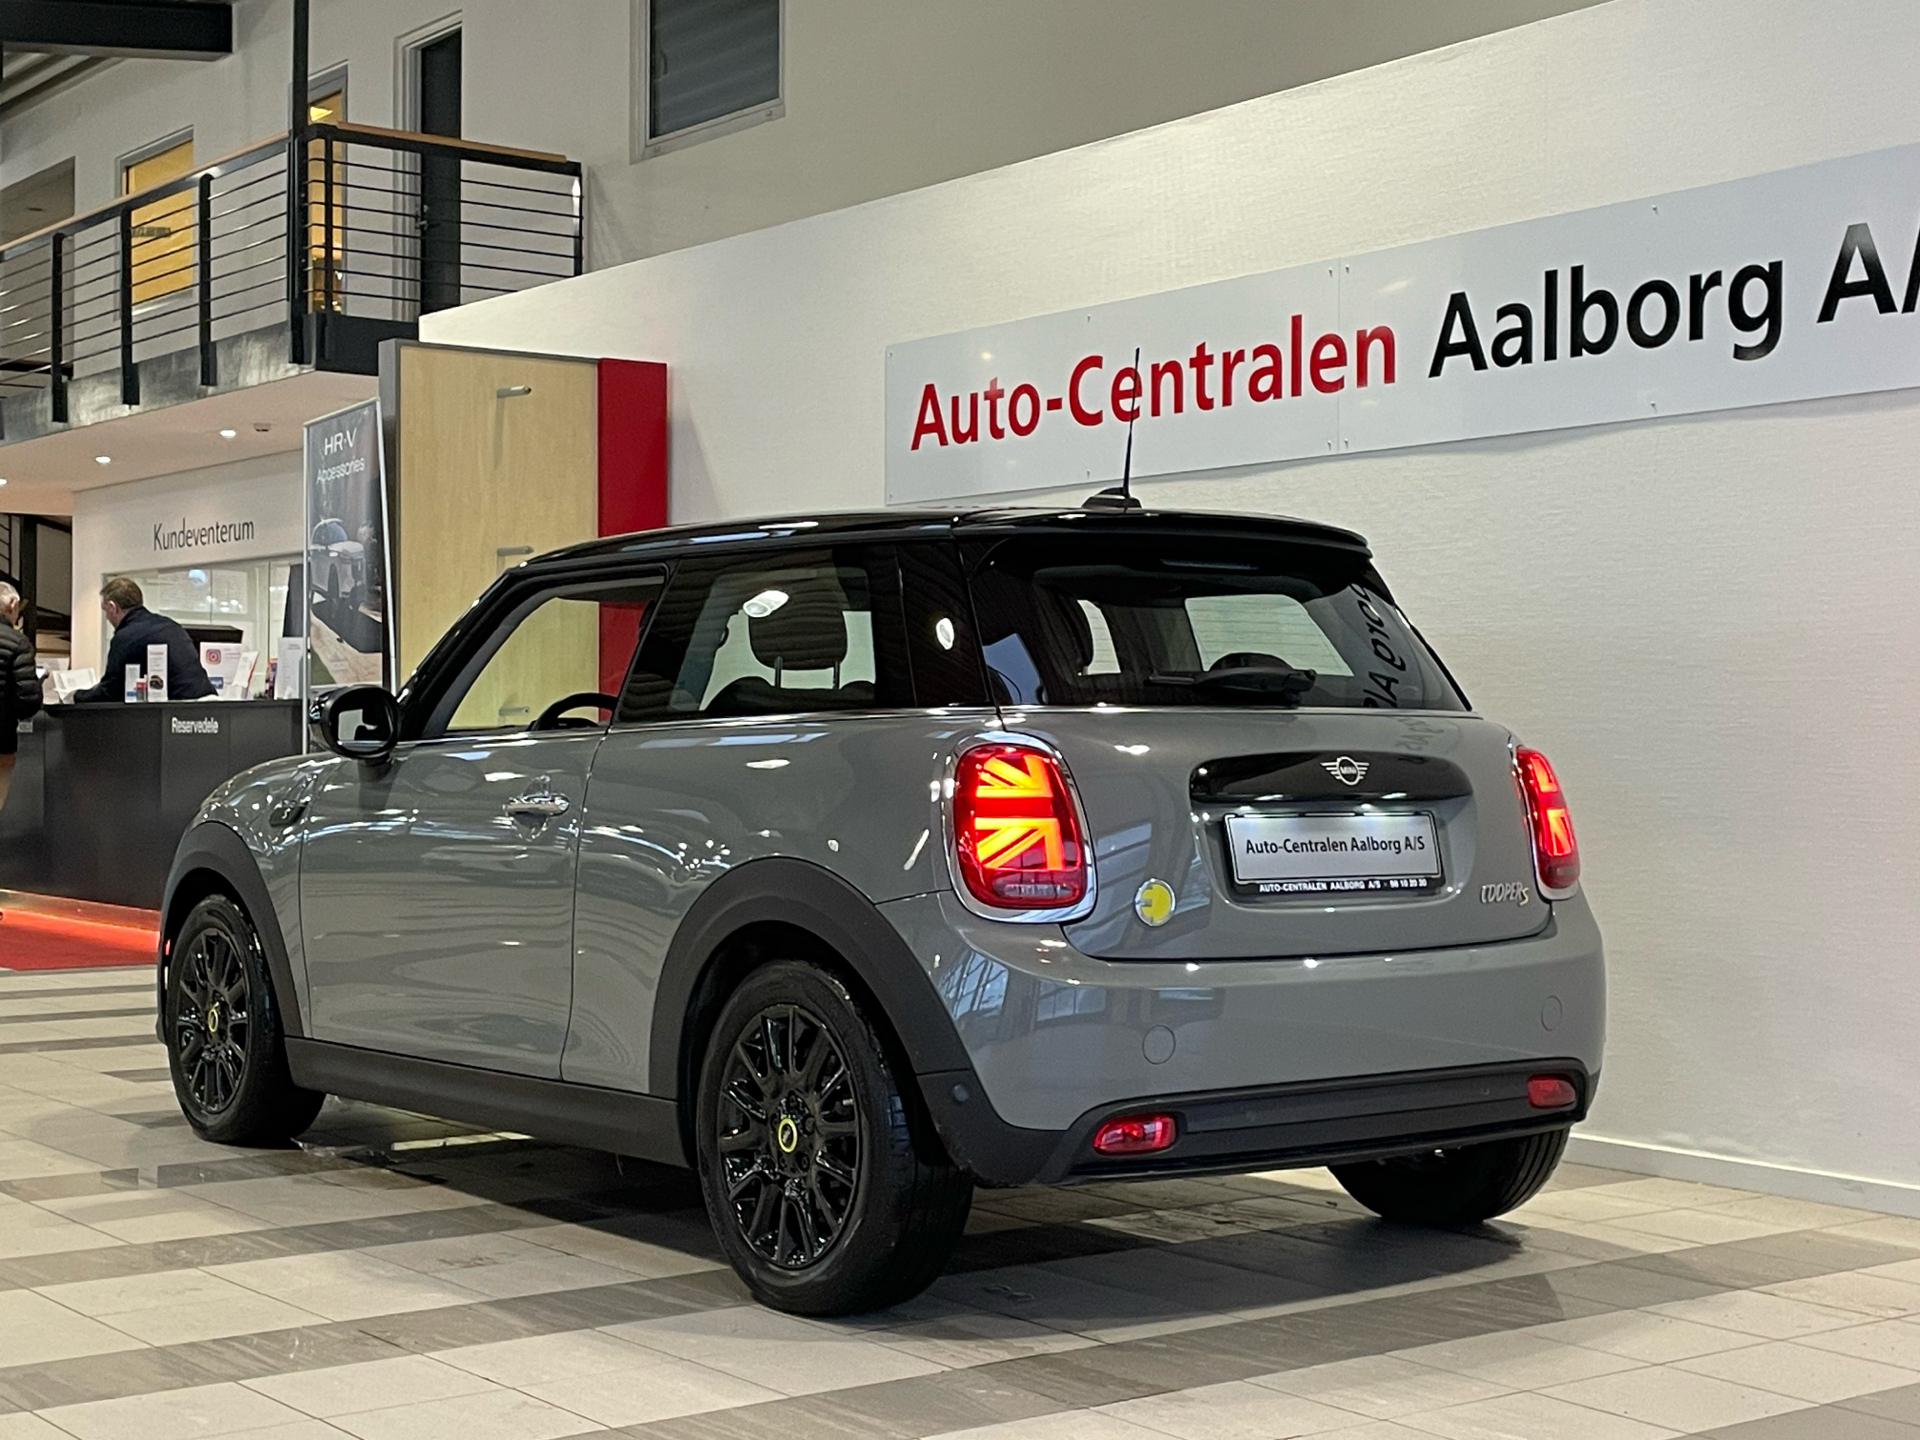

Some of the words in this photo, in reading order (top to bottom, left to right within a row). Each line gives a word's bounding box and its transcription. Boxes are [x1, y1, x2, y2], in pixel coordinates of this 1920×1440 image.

[910, 314, 1397, 451] Auto-Centralen
[1428, 260, 1784, 378] Aalborg
[324, 426, 357, 456] HR-V
[315, 457, 366, 486] Accessories
[153, 517, 255, 552] Kundeventerum
[171, 716, 219, 734] Reservedele
[1246, 836, 1348, 855] Auto-Centralen
[1350, 836, 1401, 855] Aalborg
[1404, 836, 1425, 851] A/S
[1259, 881, 1328, 893] AUTO-CENTRALEN
[1330, 880, 1366, 891] AALBORG
